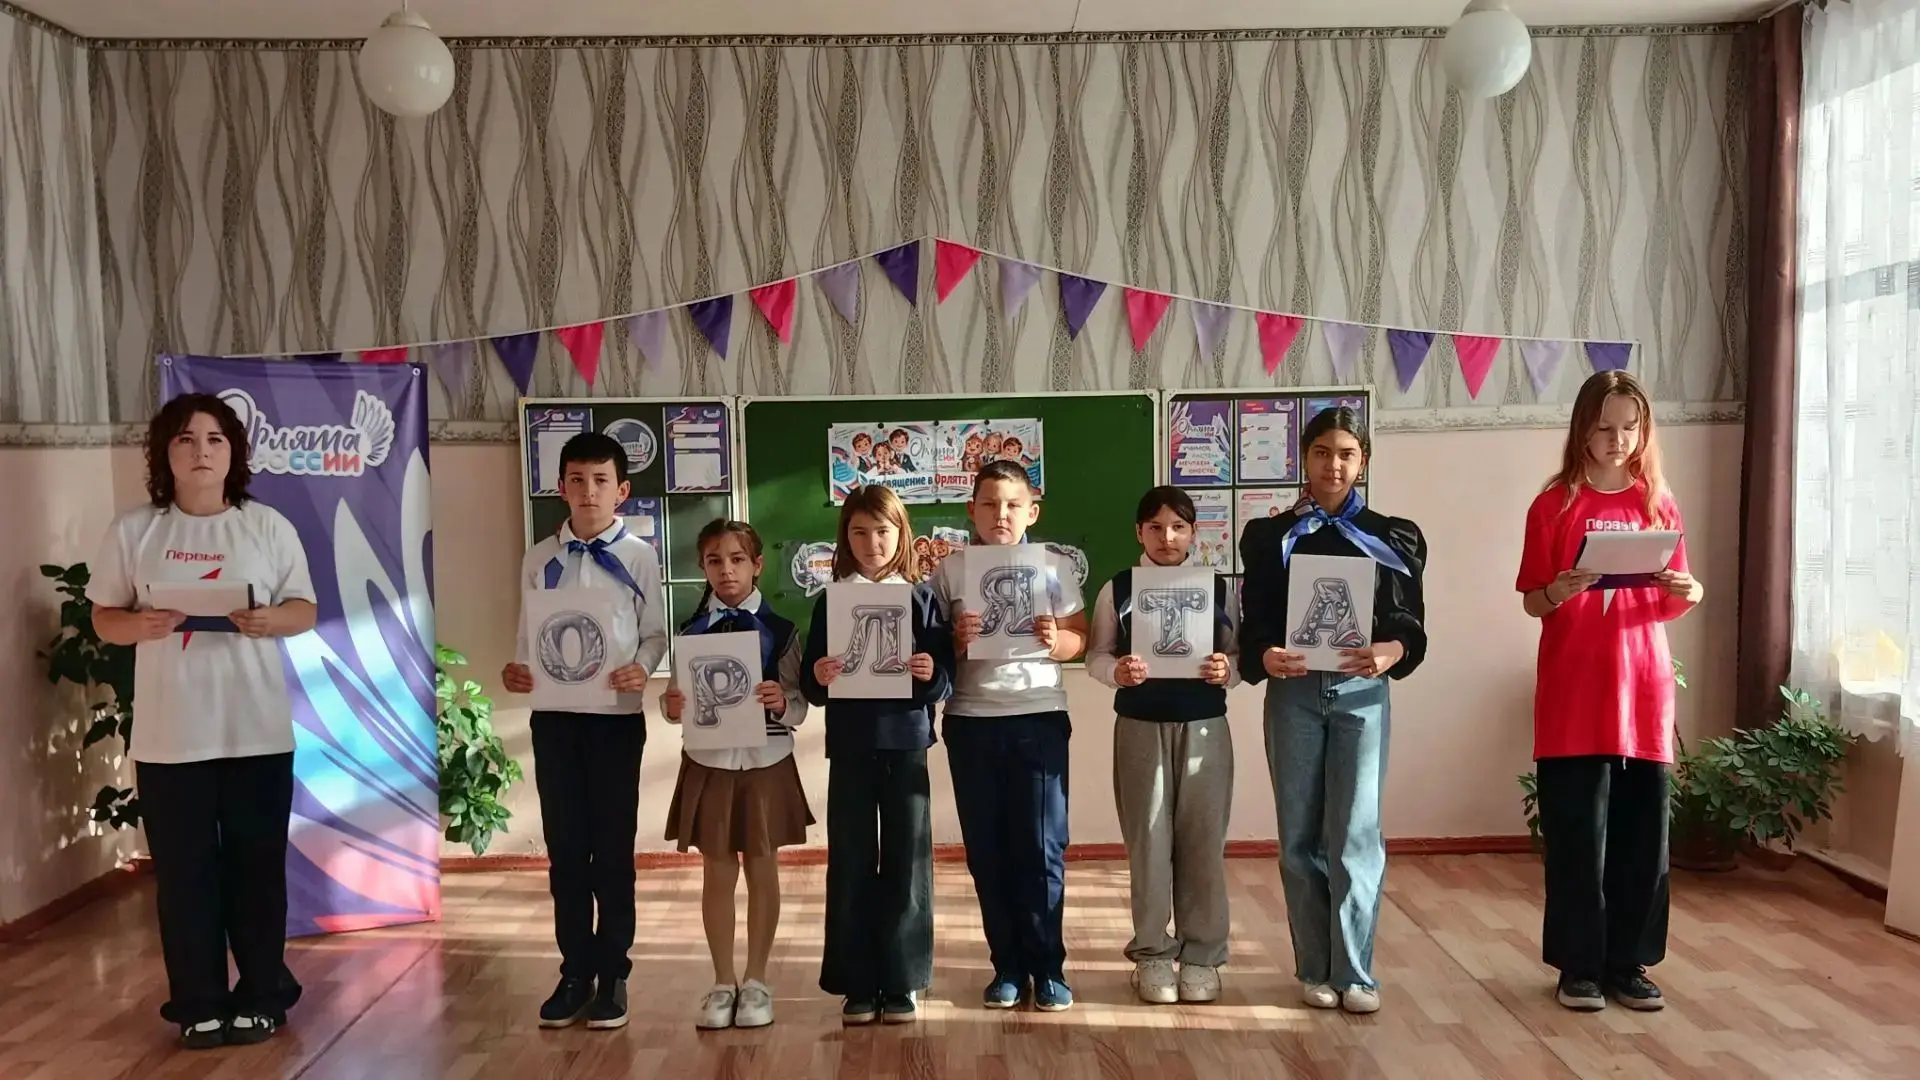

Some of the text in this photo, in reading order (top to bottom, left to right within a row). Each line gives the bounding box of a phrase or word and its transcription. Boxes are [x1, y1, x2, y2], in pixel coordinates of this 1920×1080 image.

[928, 476, 933, 485] в
[935, 473, 968, 487] Орлята
[165, 549, 225, 562] Первые
[977, 565, 1039, 638] Я
[1137, 588, 1209, 658] Т
[1290, 577, 1368, 650] А
[536, 609, 607, 685] О
[837, 604, 907, 677] Л
[689, 655, 753, 728] Р
